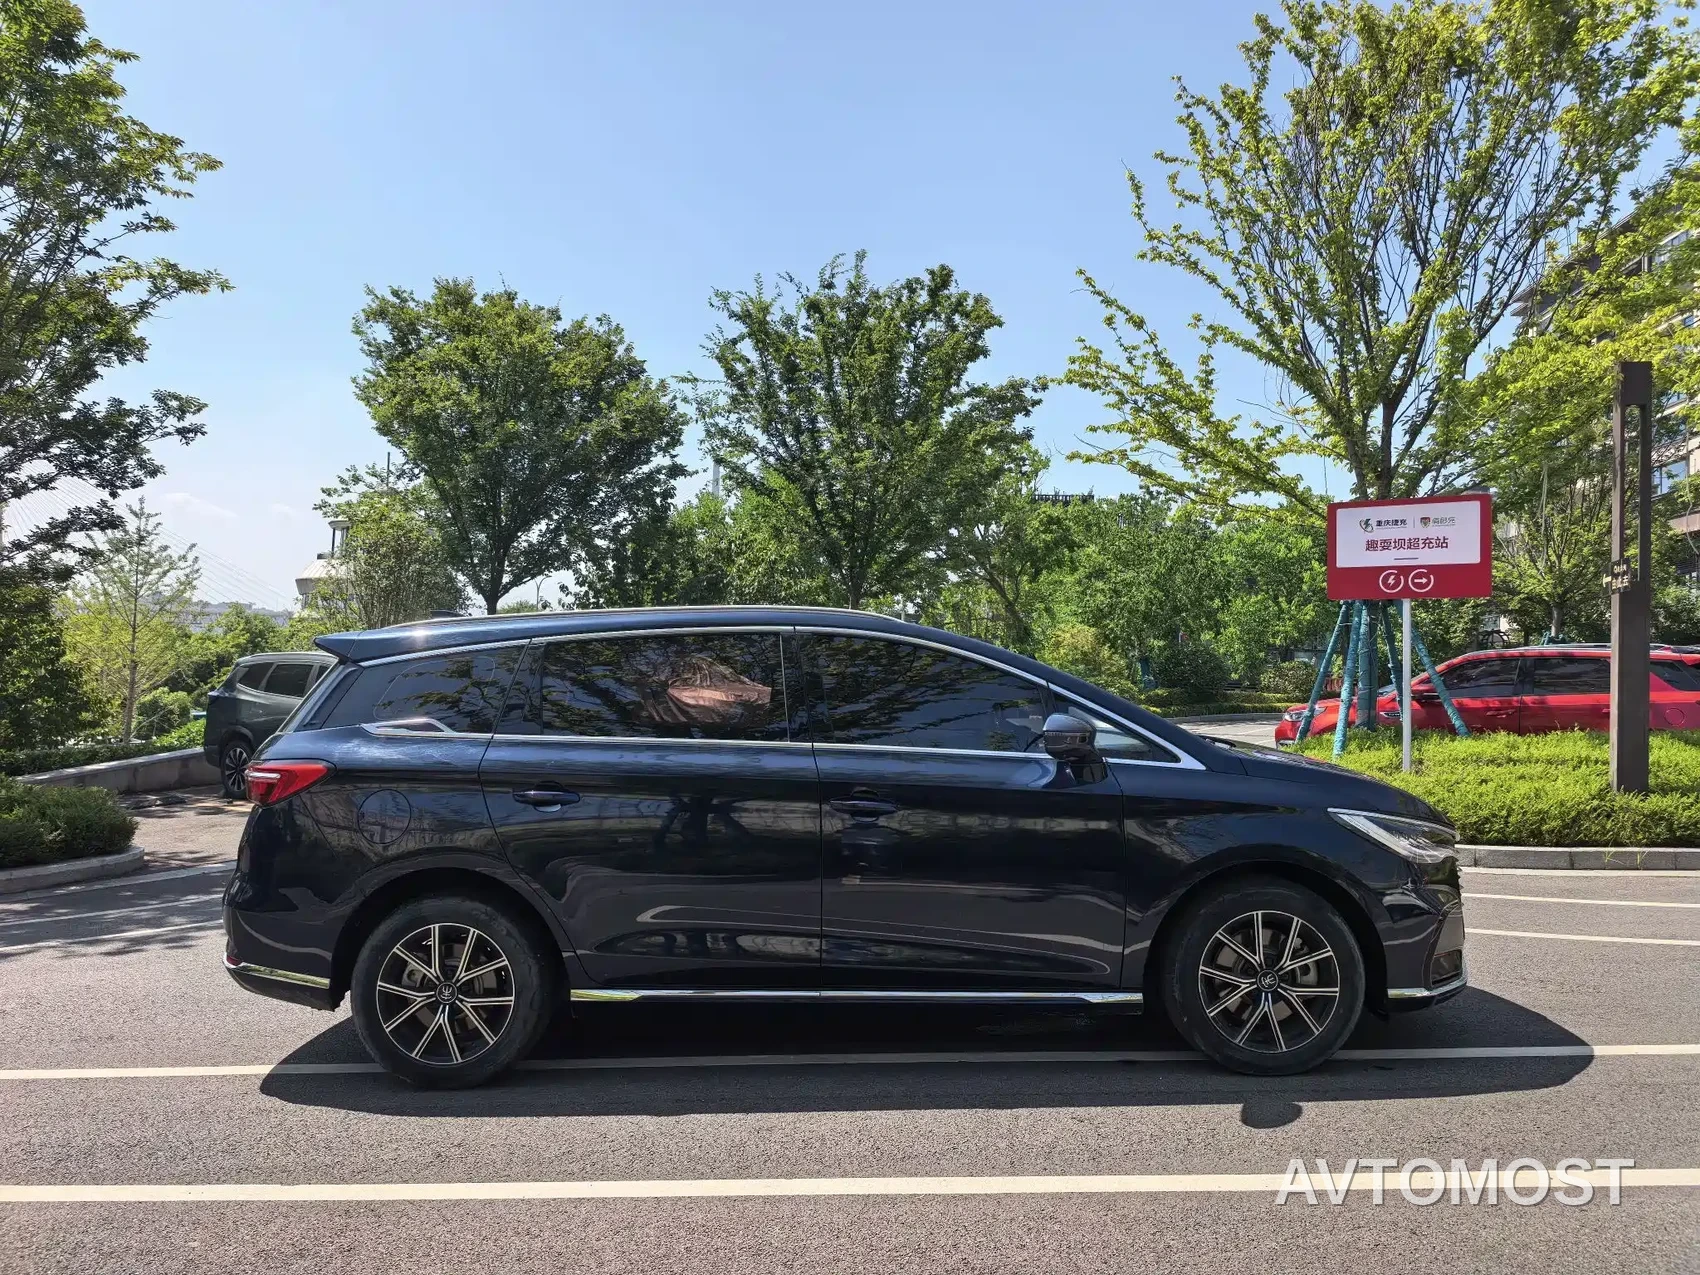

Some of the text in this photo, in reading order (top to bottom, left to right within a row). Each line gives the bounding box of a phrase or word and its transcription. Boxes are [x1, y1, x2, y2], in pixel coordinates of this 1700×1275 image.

[1365, 535, 1449, 552] 趣耍坝超充站
